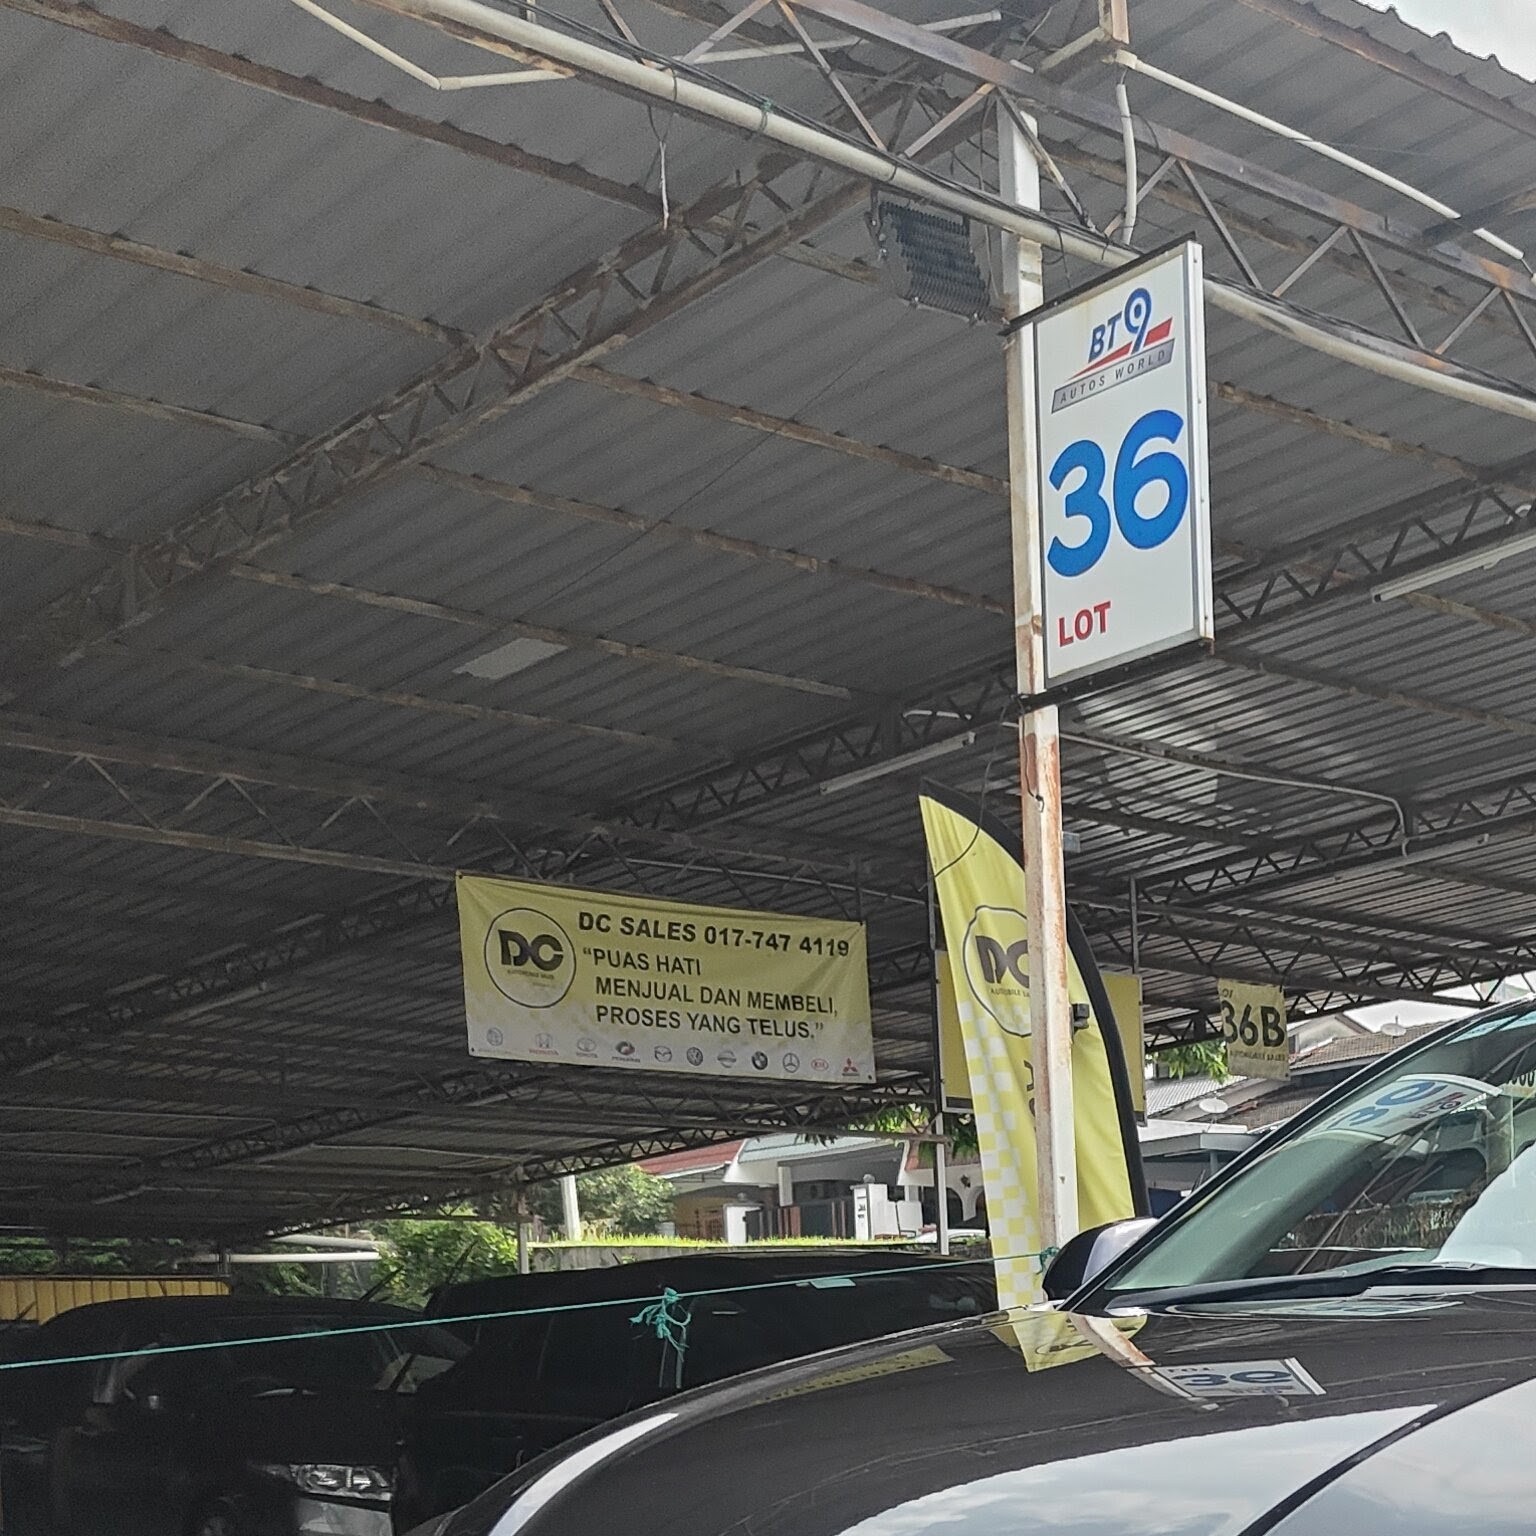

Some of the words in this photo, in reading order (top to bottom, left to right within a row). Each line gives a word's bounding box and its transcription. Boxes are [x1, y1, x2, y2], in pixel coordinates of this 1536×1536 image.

[1088, 287, 1152, 364] BT9
[1060, 376, 1106, 404] AUTOS
[1114, 349, 1167, 380] WORLD
[1047, 409, 1188, 577] 36
[1058, 601, 1111, 647] LOT
[498, 929, 564, 972] DC
[579, 912, 611, 933] DC
[619, 917, 696, 942] SALES
[705, 926, 791, 952] 017-747
[799, 937, 850, 957] 4119
[656, 954, 701, 976] HATI
[596, 977, 694, 1004] MENJUAL
[700, 985, 741, 1008] DAN
[747, 991, 839, 1018] MEMBELI,
[597, 1005, 681, 1029] PROSES
[688, 1012, 741, 1034] YANG
[1221, 1000, 1285, 1048] 36B
